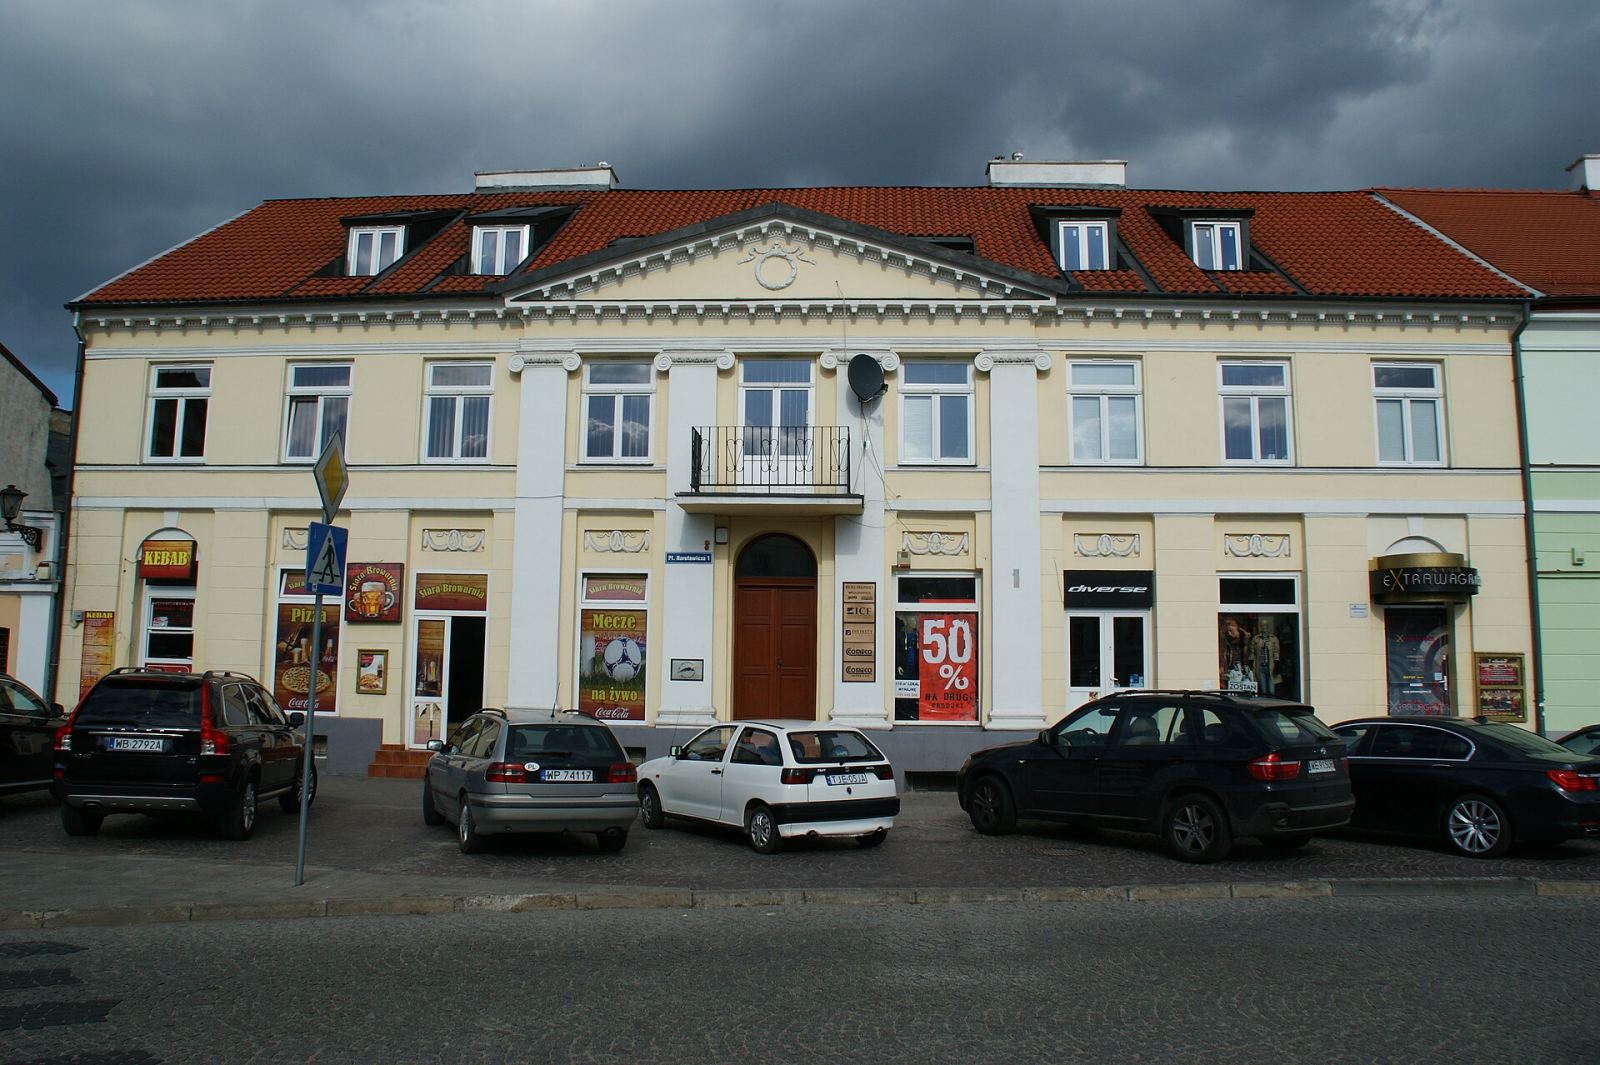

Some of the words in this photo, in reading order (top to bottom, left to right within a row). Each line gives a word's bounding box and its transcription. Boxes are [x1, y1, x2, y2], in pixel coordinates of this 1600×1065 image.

[144, 551, 189, 566] KEBAB
[349, 572, 365, 591] Stara
[367, 566, 398, 591] Browarnia
[419, 585, 440, 598] Stara
[443, 584, 485, 599] Browarnia
[1067, 584, 1148, 593] diverse
[291, 608, 327, 622] Piza
[593, 613, 636, 629] Mecze
[923, 619, 971, 664] 50
[939, 664, 969, 690] %
[591, 689, 606, 700] na
[609, 687, 638, 702] żywo
[925, 693, 938, 701] NA
[115, 739, 130, 749] WB
[132, 740, 161, 750] 2792A
[546, 771, 561, 780] WP
[564, 771, 592, 780] 74117
